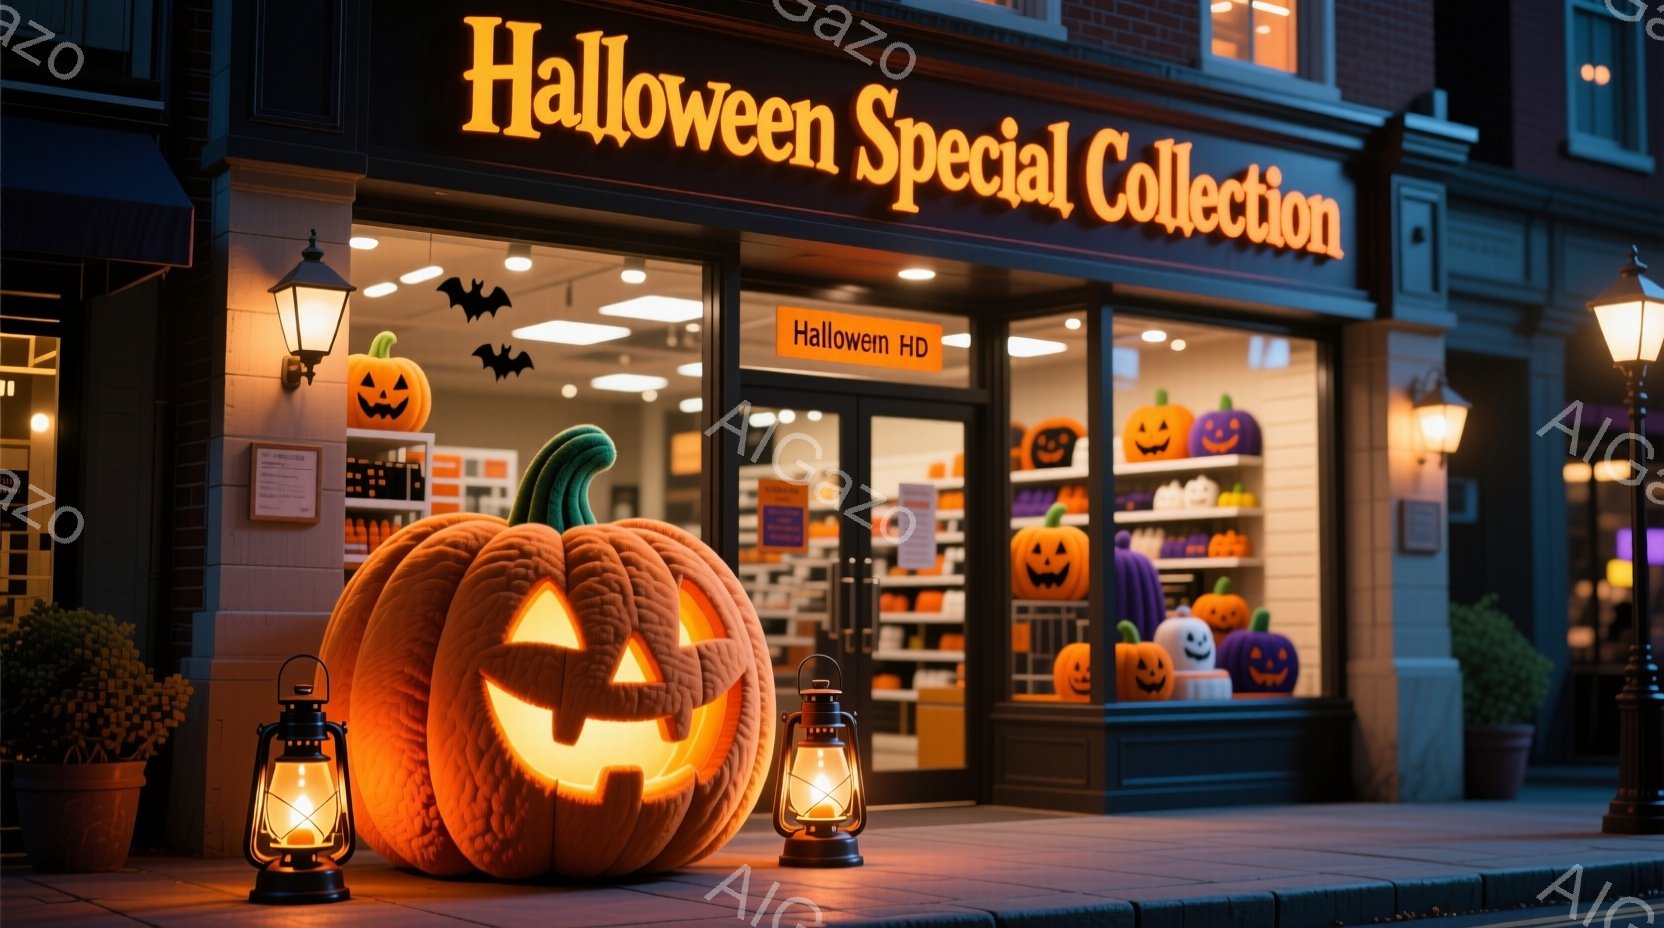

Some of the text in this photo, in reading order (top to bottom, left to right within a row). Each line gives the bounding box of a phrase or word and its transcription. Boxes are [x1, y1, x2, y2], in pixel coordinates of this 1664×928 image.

[462, 16, 1344, 260] Halloween Special Collection
[900, 334, 929, 358] HD
